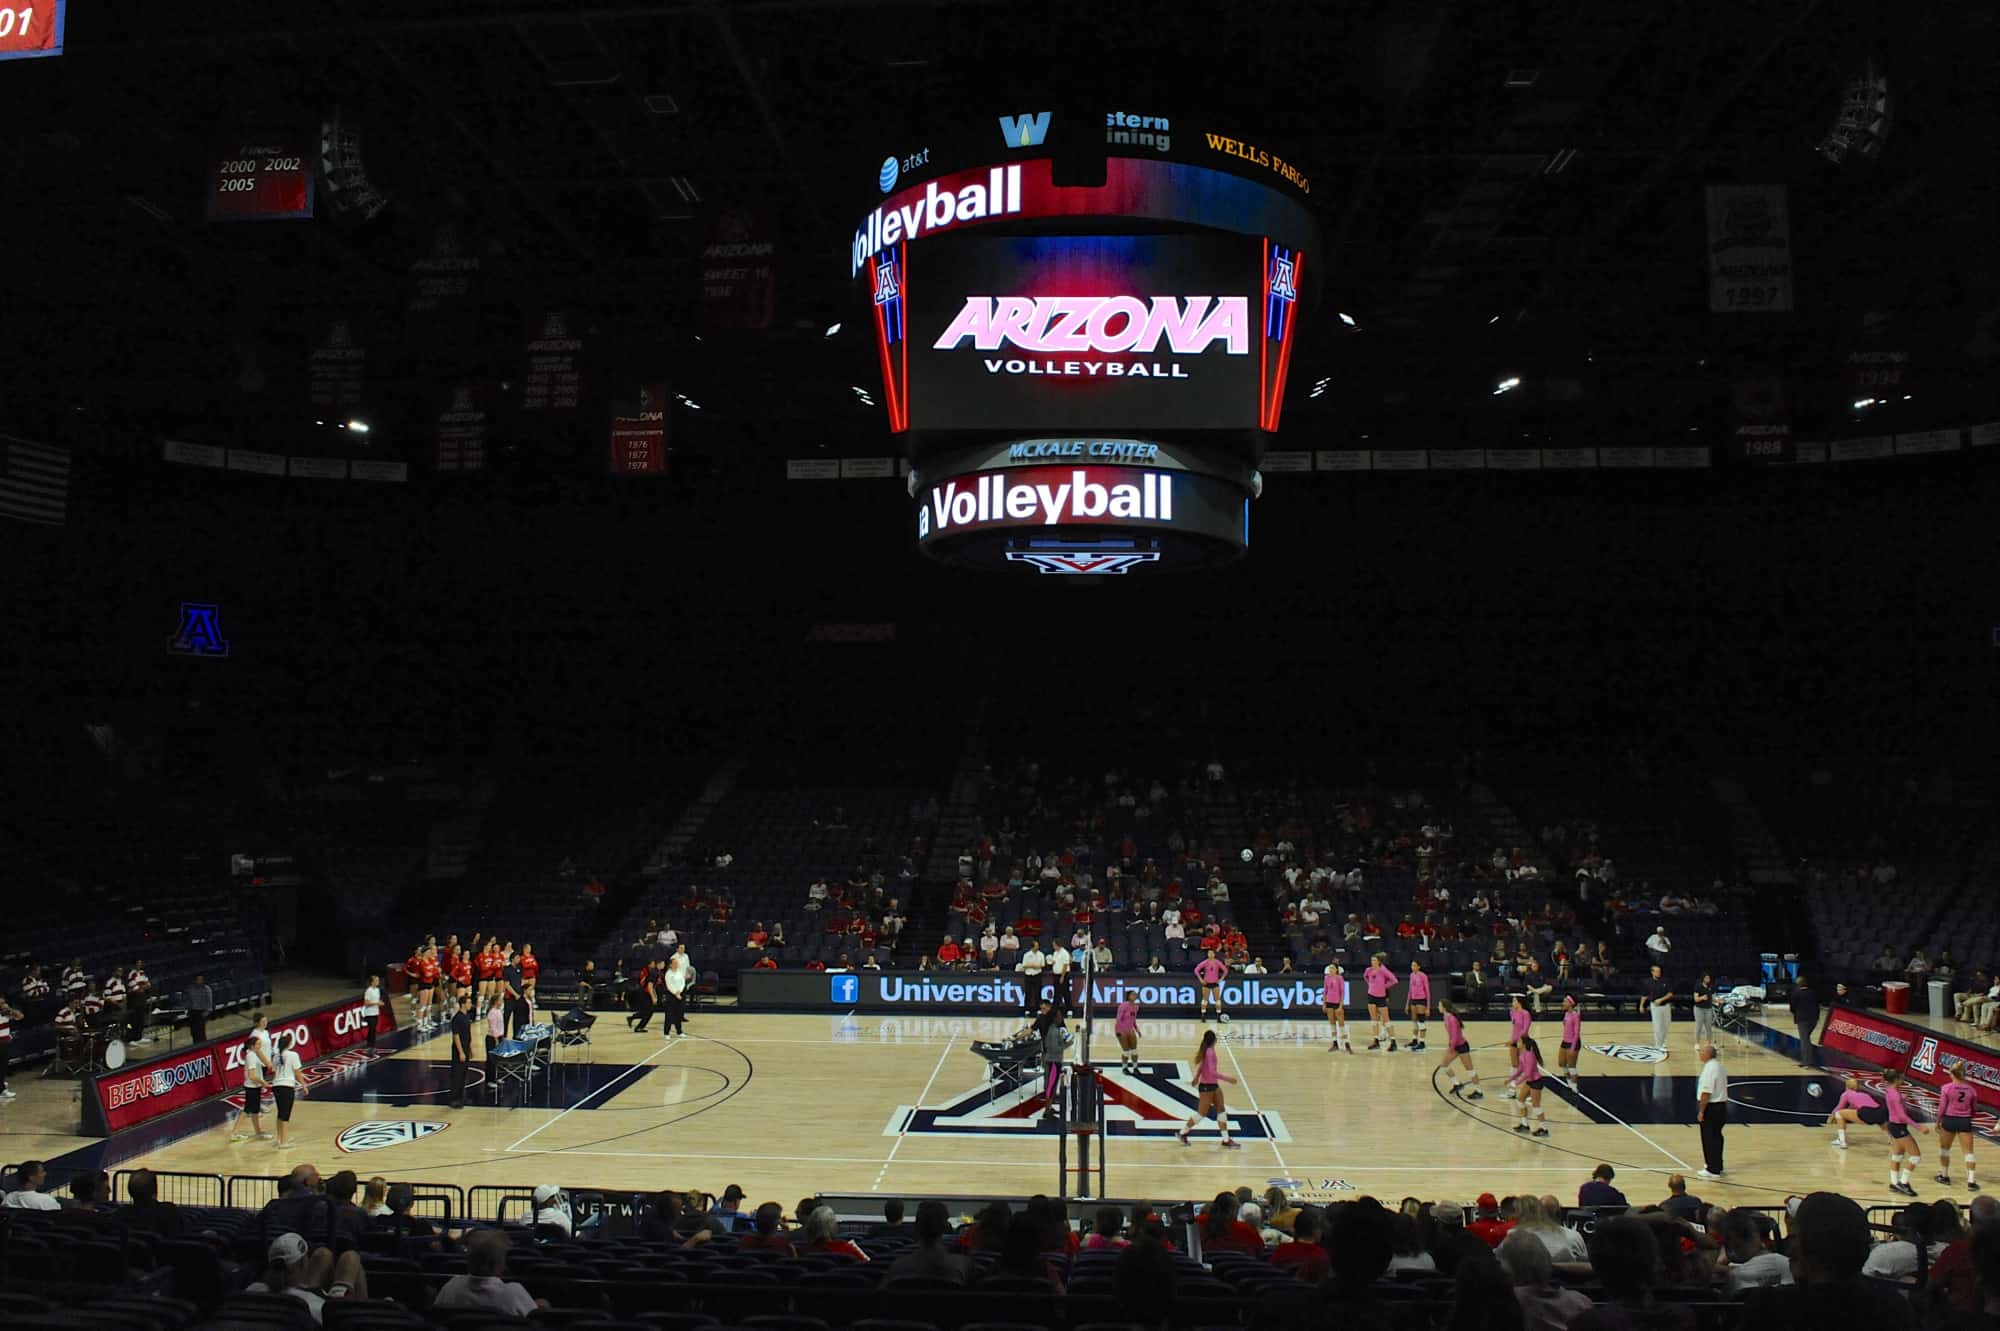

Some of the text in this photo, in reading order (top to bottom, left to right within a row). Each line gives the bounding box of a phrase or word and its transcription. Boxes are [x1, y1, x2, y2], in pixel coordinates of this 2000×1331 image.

[219, 157, 301, 174] 2000 2002
[902, 148, 930, 173] at&t
[1206, 132, 1311, 194] WELLS FARGO
[219, 178, 256, 192] 2005
[932, 295, 1249, 355] ARIZONA
[984, 359, 1189, 379] VOLLEYBALL
[1087, 441, 1159, 459] CENTER
[933, 471, 1172, 525] Volleyball
[879, 976, 1026, 1007] University
[109, 1074, 157, 1110] BEAR
[163, 1055, 213, 1091] DOWN
[1957, 1091, 1966, 1104] 2
